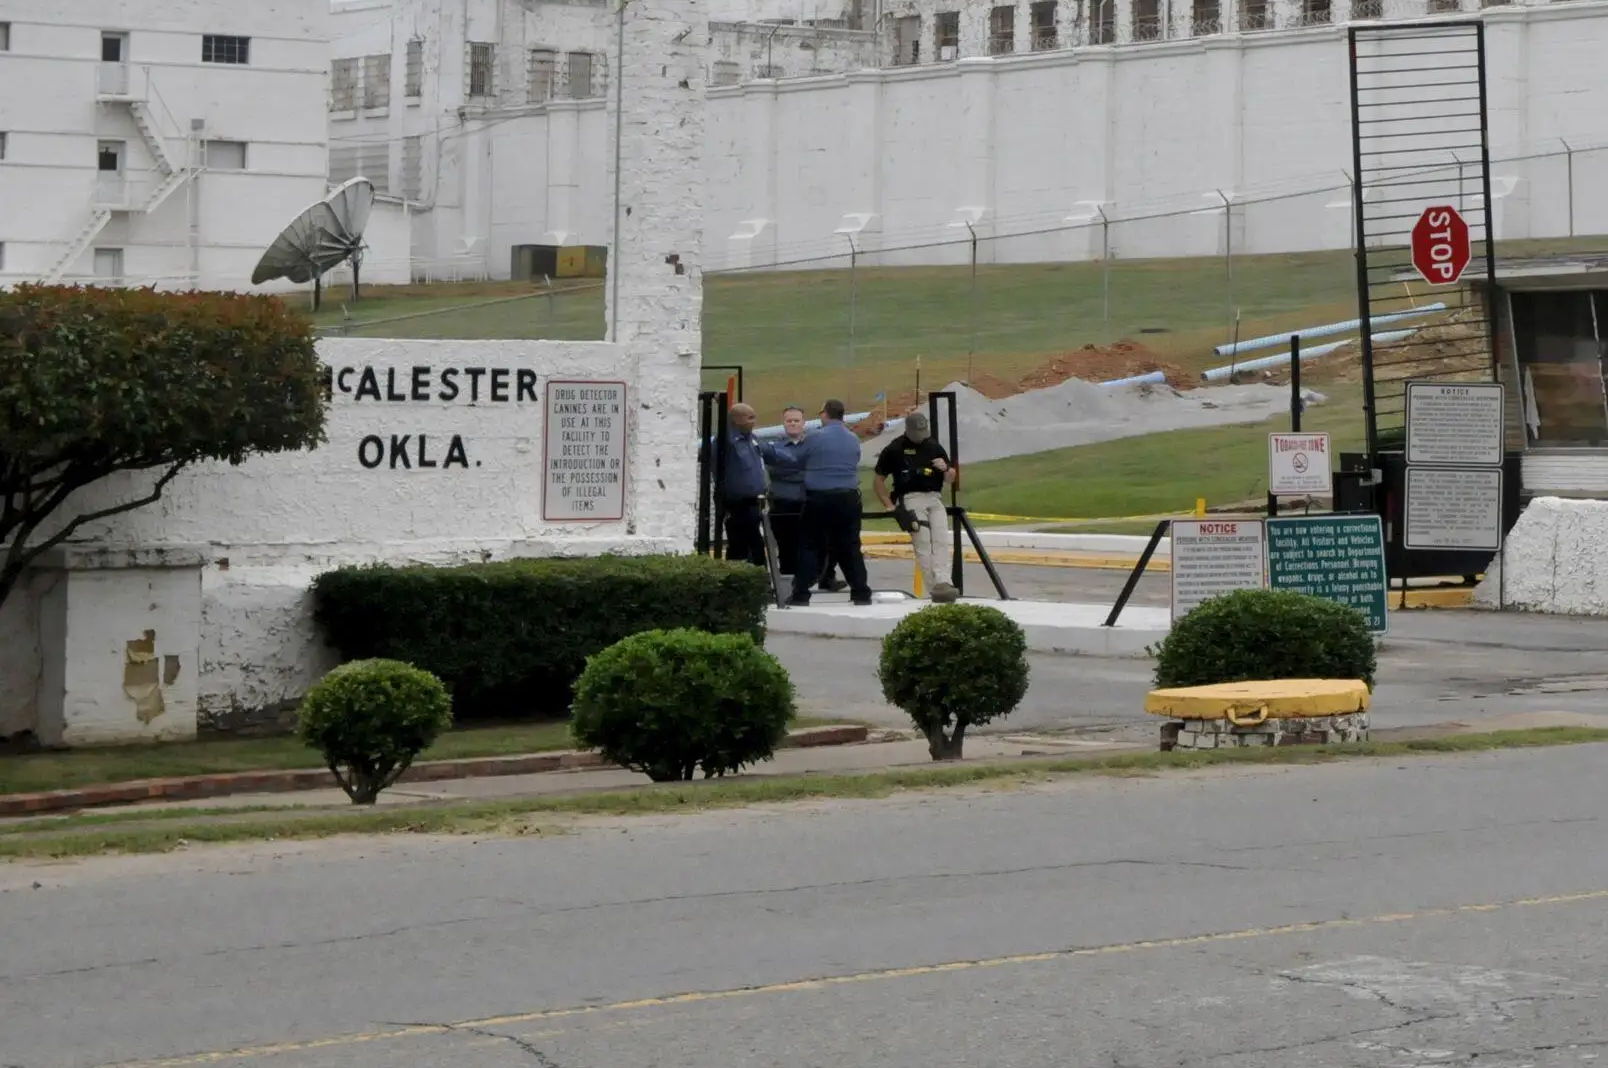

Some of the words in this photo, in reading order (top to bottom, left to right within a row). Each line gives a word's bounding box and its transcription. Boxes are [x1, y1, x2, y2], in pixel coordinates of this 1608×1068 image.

[1429, 212, 1453, 279] STOP
[555, 389, 576, 400] DRUG
[580, 390, 617, 400] DETECTOR
[554, 403, 587, 414] CANINES
[592, 403, 606, 414] ARE
[611, 403, 619, 414] IN
[561, 417, 576, 428] USE
[581, 417, 589, 428] AT
[595, 417, 611, 428] THIS
[562, 431, 595, 442] FACILITY
[601, 431, 610, 442] TO
[358, 434, 482, 469] OKLA.
[562, 445, 590, 456] DETECT
[595, 445, 608, 456] THE
[550, 458, 606, 470] INTRODUCTION
[610, 459, 619, 469] OR
[552, 473, 566, 484] THE
[570, 473, 618, 484] POSSESSION
[562, 486, 572, 497] OF
[576, 486, 606, 497] ILLEGAL
[572, 500, 594, 511] ITEMS
[1200, 524, 1237, 533] NOTICE
[1343, 523, 1377, 533] correctional
